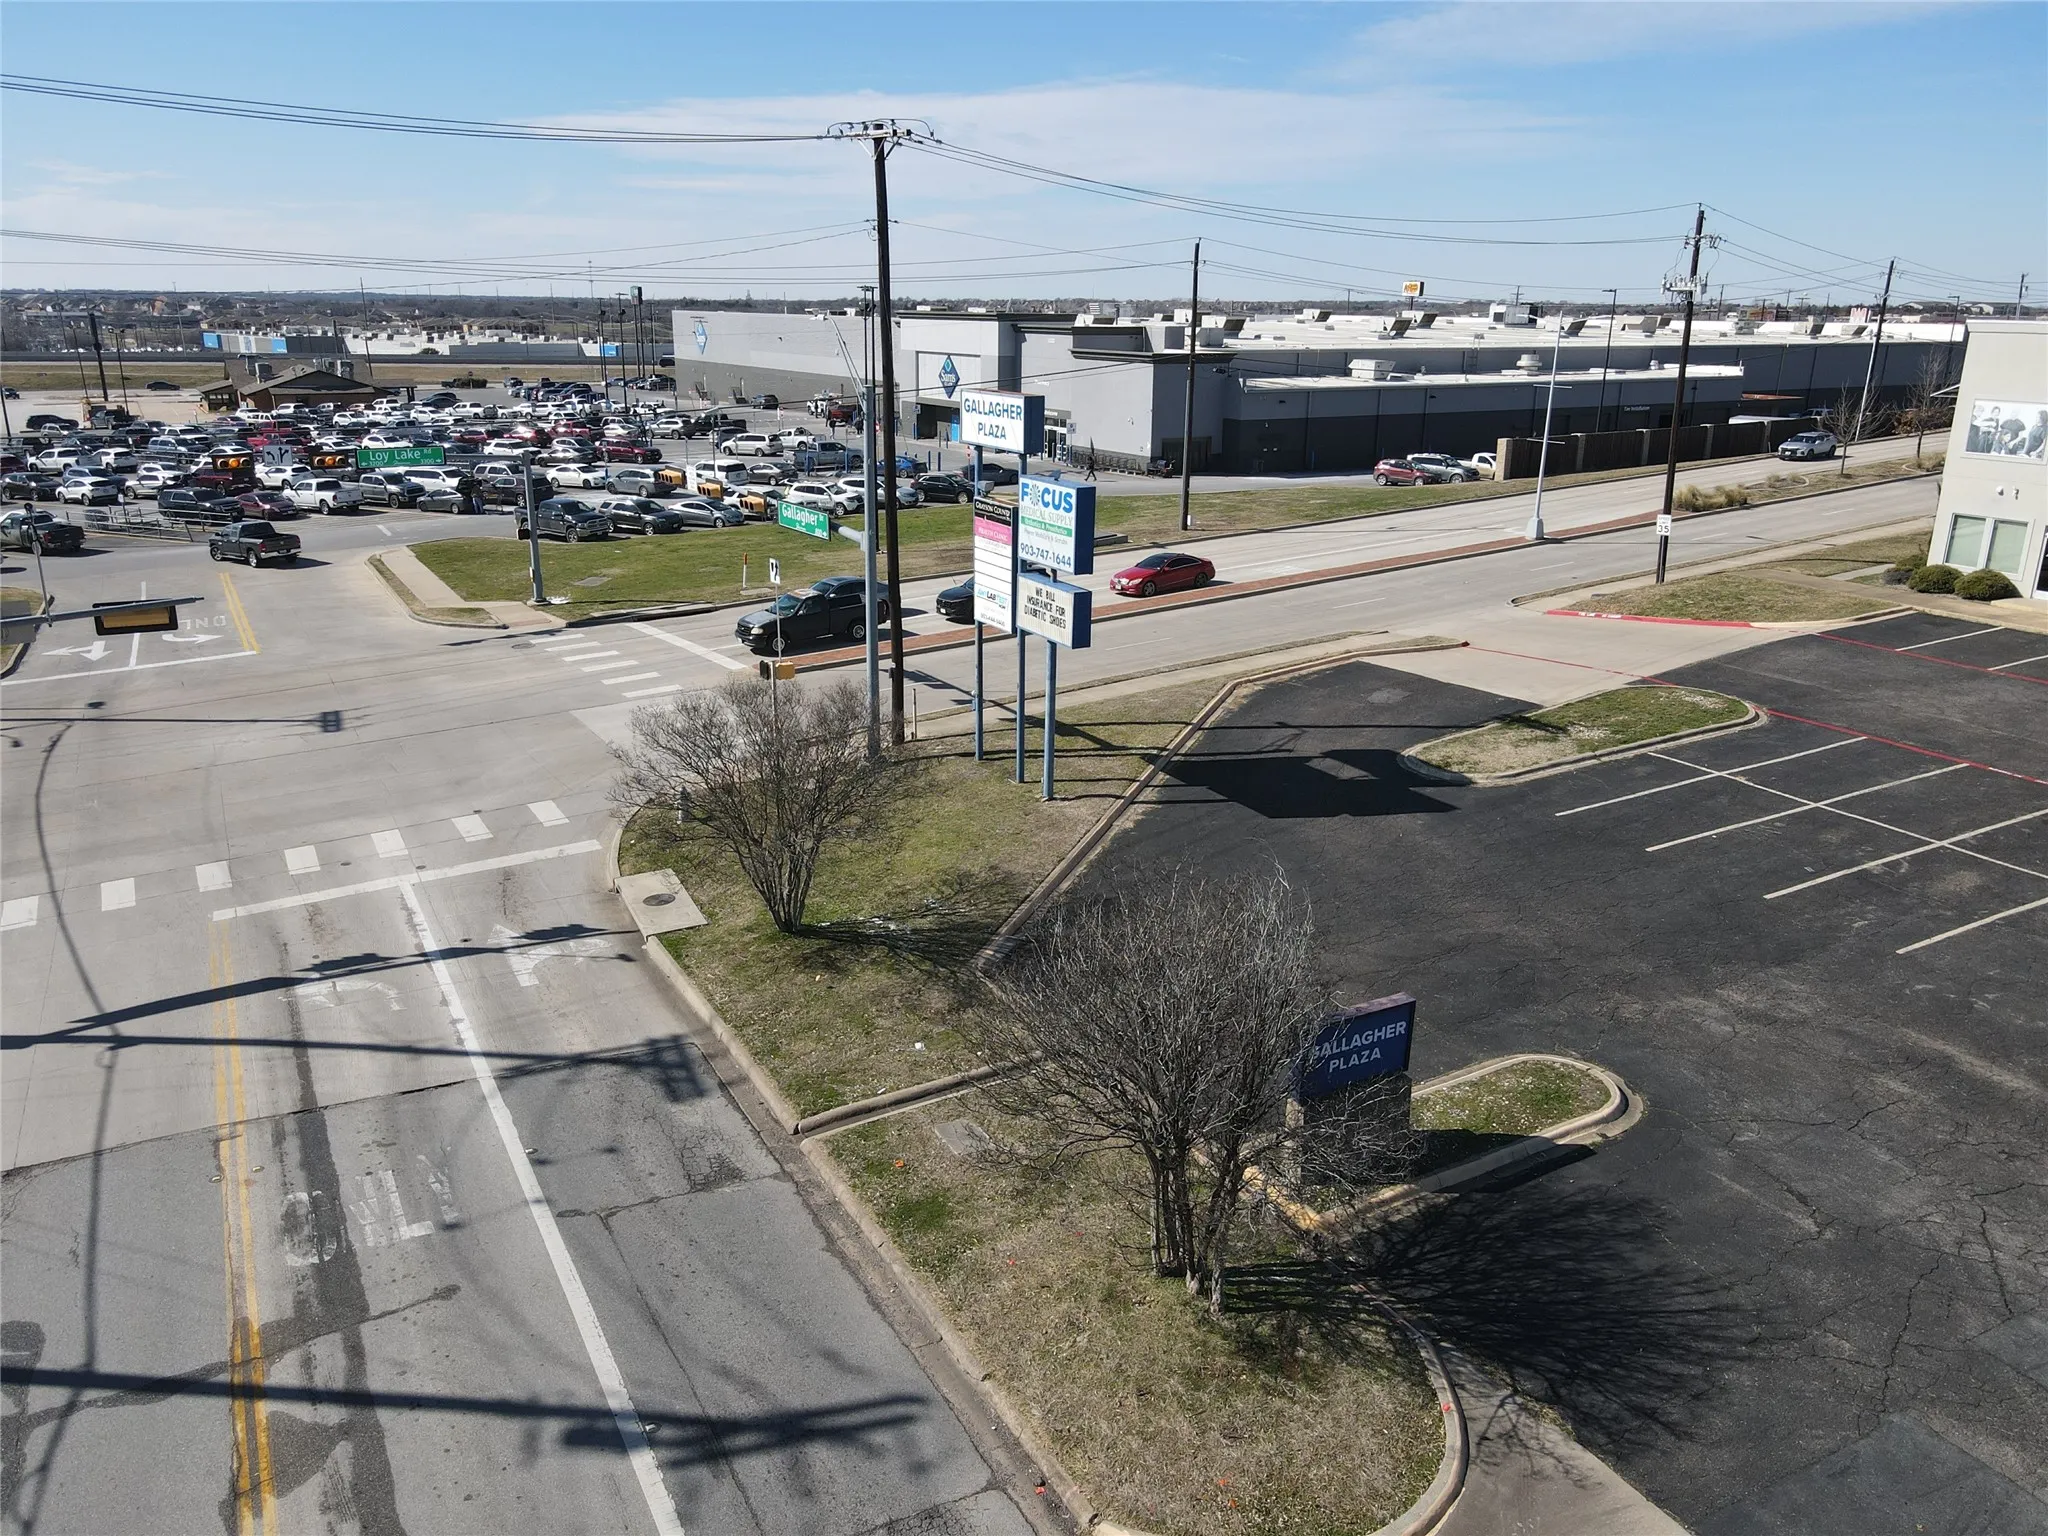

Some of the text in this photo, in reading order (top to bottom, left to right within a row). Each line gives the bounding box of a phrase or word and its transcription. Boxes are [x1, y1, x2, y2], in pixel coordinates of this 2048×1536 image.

[963, 398, 1023, 421] GALLAGHER
[977, 422, 1007, 440] PLAZA
[369, 451, 389, 463] Loy
[394, 449, 421, 460] Lake
[781, 503, 818, 526] Gallagher
[1020, 504, 1073, 527] MEDICAL SUPPLY
[1657, 524, 1670, 534] 35
[1020, 543, 1072, 568] 903-747-1644
[986, 590, 996, 600] LAB
[1035, 586, 1055, 602] WE BILL
[1024, 604, 1046, 622] DIABETIC
[1049, 614, 1067, 629] SHOES
[1026, 595, 1066, 617] INSURANCE FOR
[179, 615, 227, 630] ONL
[1328, 1047, 1382, 1073] PLAZA
